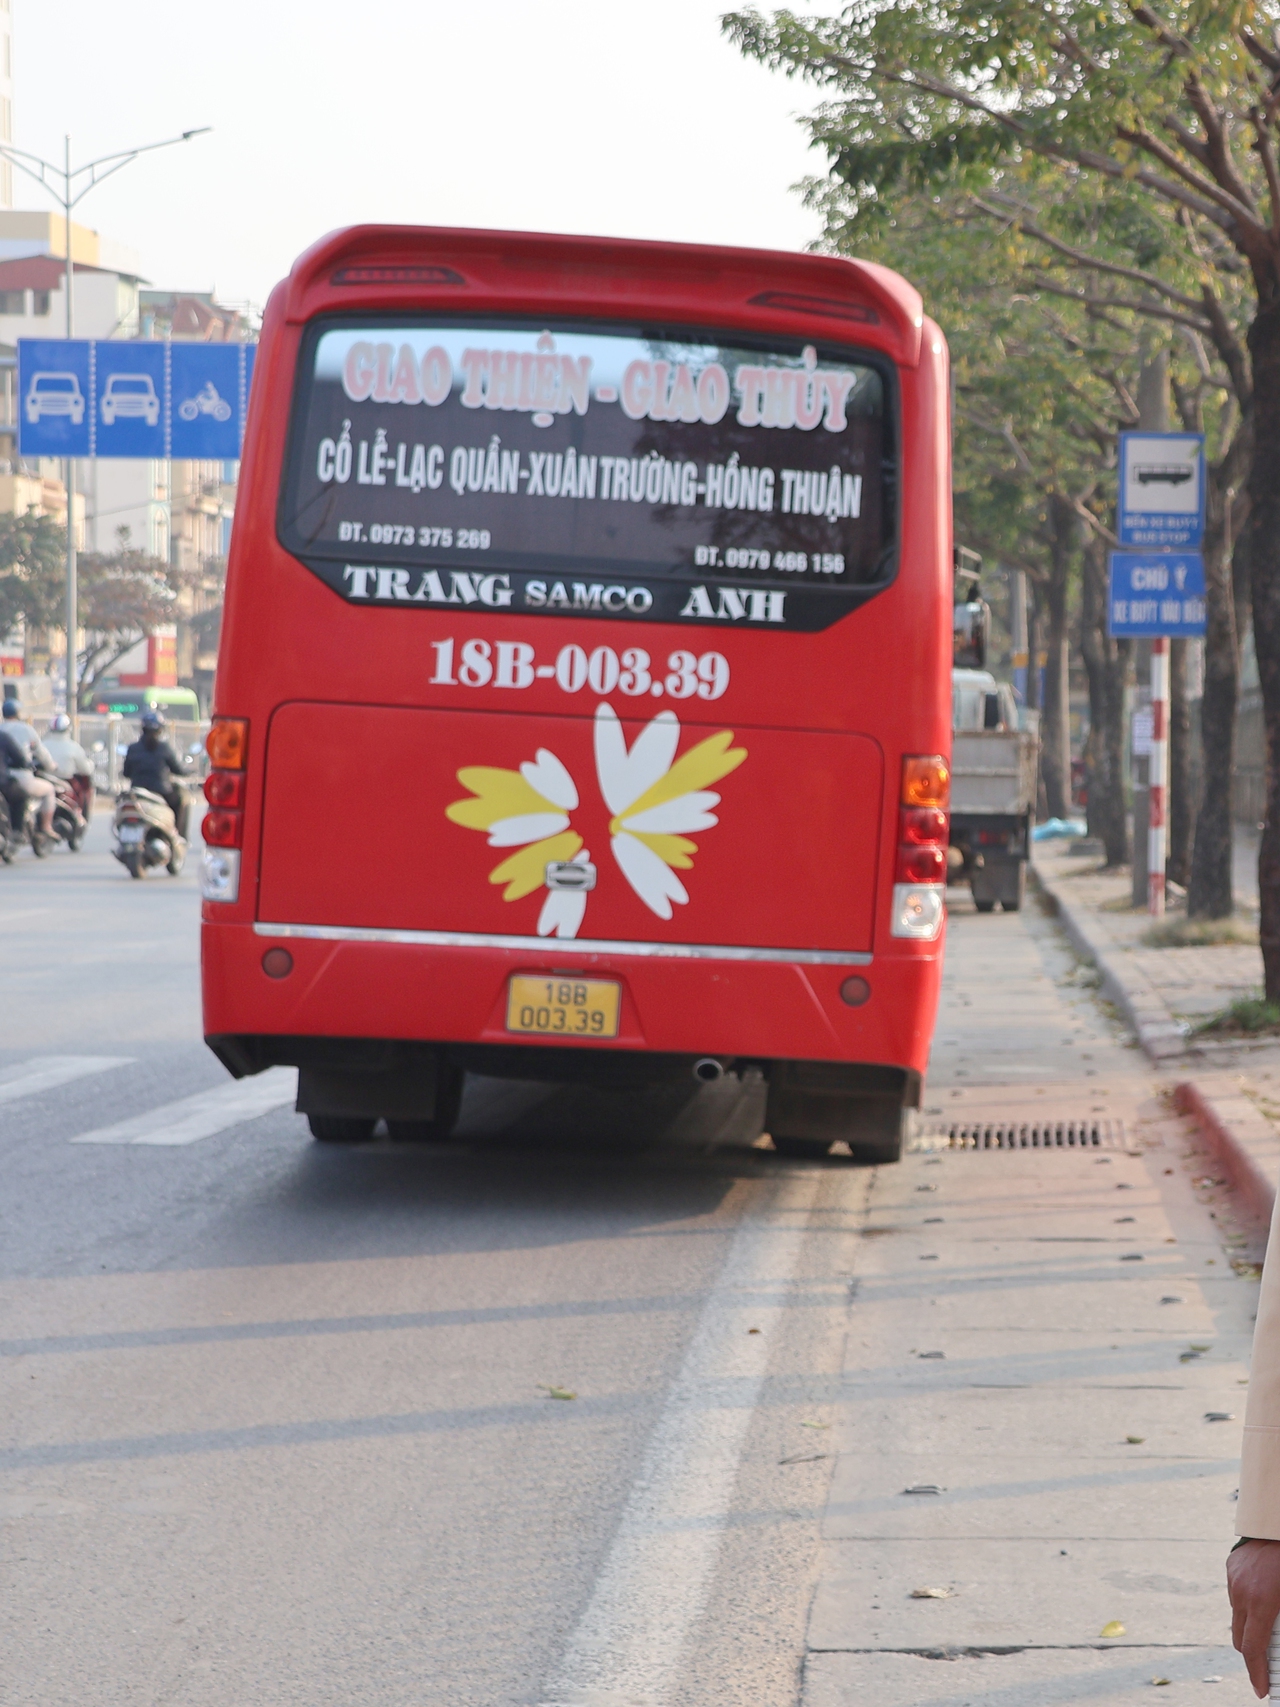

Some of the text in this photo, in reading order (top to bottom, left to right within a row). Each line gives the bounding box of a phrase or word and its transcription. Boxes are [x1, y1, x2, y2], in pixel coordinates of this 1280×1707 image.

[343, 341, 452, 406] GIAO
[460, 329, 594, 428] THIỆN
[620, 359, 730, 425] GIAO
[735, 345, 857, 432] THỦY
[317, 418, 352, 483] CỔ
[781, 465, 862, 523] THUẬN
[370, 524, 414, 546] 0973
[418, 527, 453, 548] 375
[725, 547, 770, 570] 0979
[343, 564, 788, 623] TRANG SAMCO ANH
[1130, 563, 1169, 592] CHÚ
[428, 636, 731, 701] 18B-003.39
